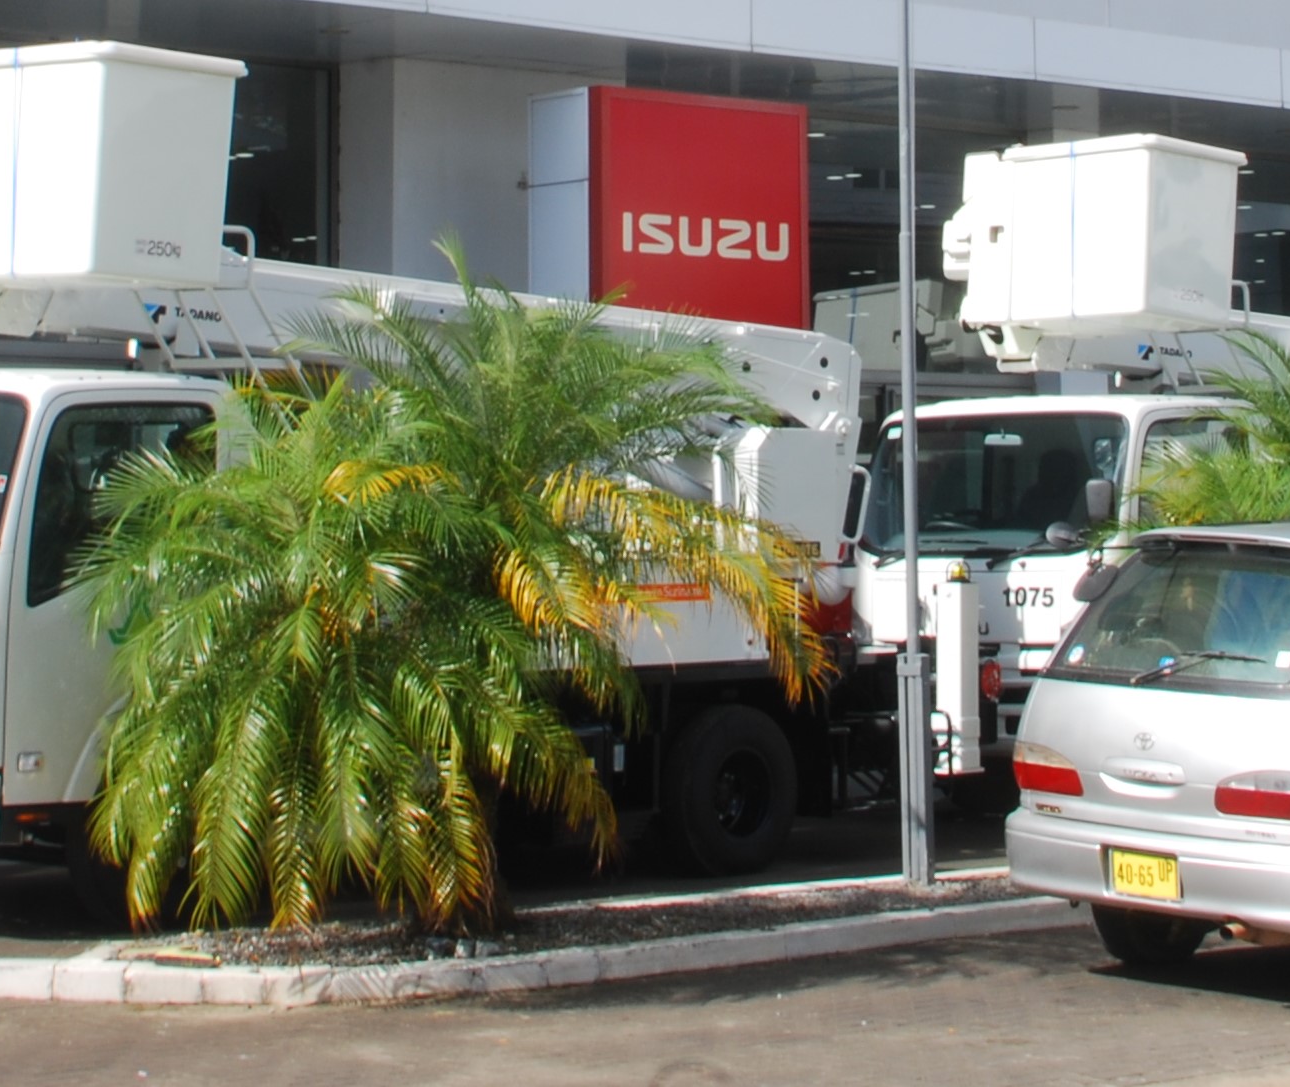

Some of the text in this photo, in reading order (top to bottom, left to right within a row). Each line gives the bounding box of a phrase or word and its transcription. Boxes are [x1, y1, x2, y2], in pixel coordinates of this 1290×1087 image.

[621, 211, 790, 262] ISUZU
[1159, 346, 1193, 358] TADAO
[1002, 586, 1055, 608] 1075
[1116, 862, 1154, 888] 40-65
